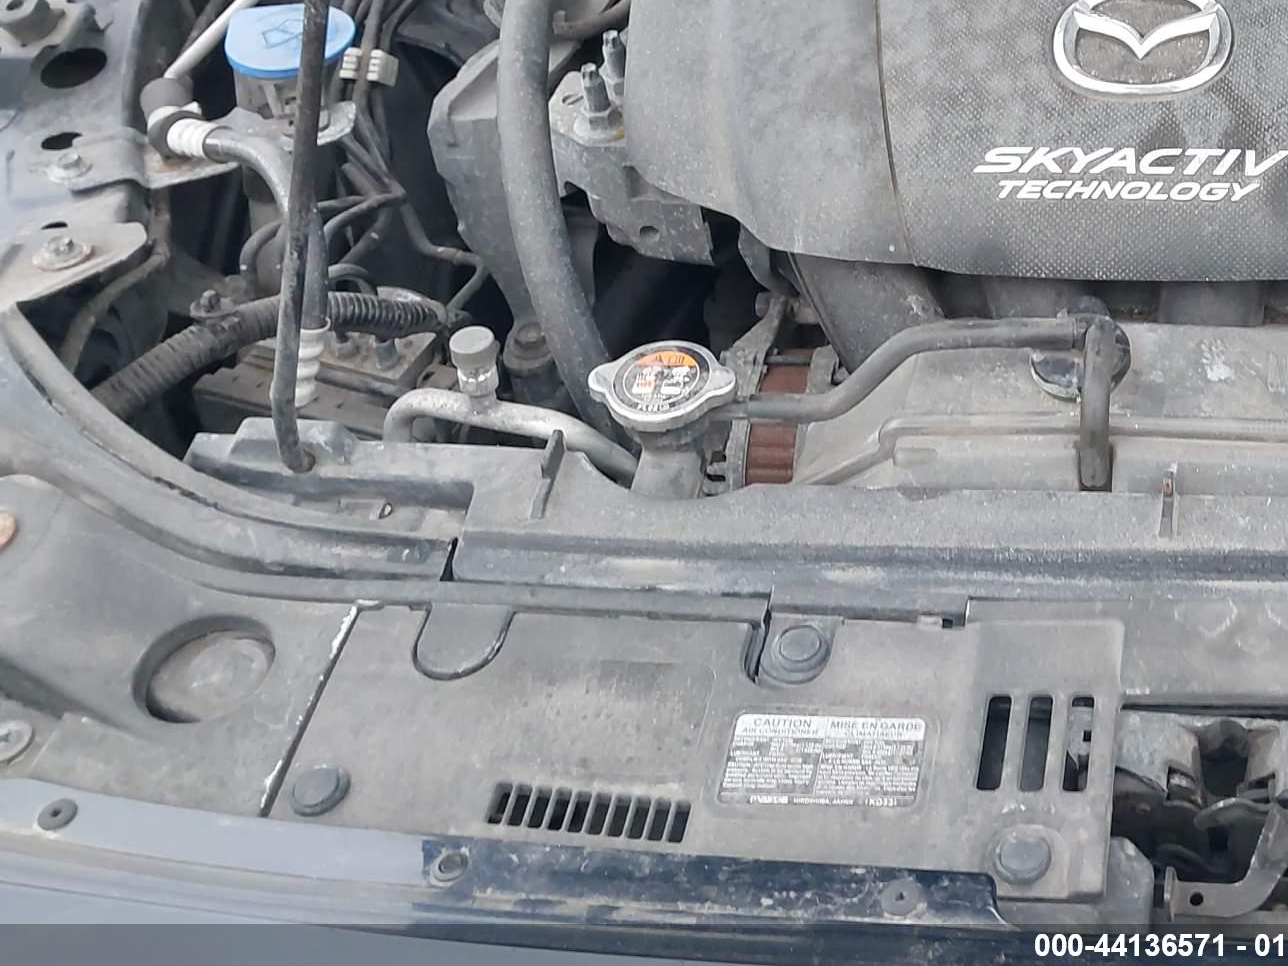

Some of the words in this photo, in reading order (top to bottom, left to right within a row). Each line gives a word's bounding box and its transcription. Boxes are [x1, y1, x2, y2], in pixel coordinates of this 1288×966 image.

[999, 179, 1260, 201] TECHNOLOGY
[754, 718, 812, 729] CAUTION
[830, 721, 858, 731] MISE
[861, 722, 878, 731] EN
[879, 722, 921, 732] GARDE
